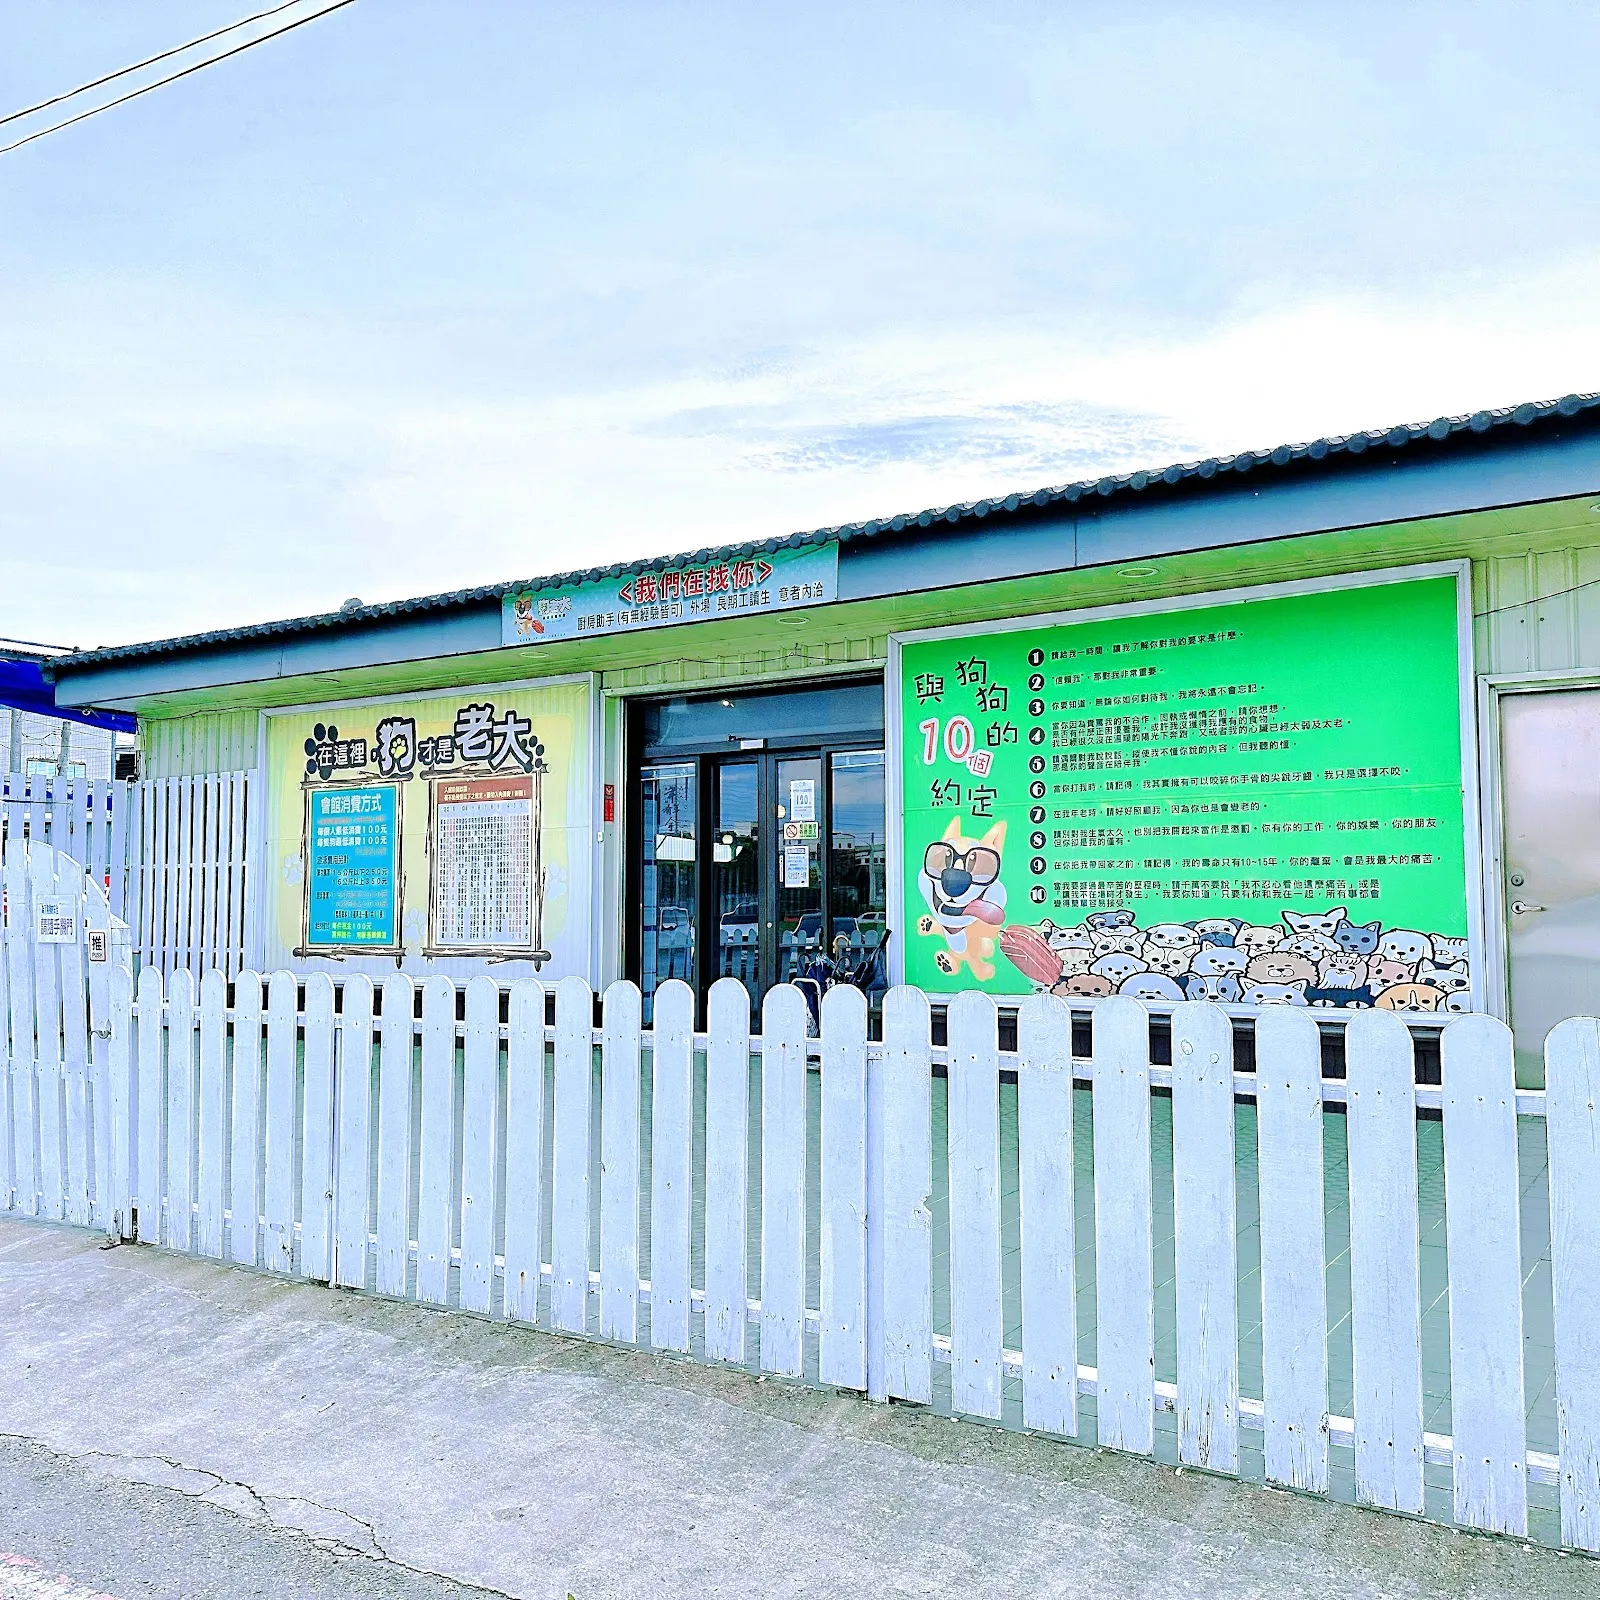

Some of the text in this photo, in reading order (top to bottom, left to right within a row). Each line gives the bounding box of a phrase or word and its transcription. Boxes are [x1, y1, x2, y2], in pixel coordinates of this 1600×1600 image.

[690, 598, 710, 615] 外場
[321, 793, 382, 814] 會館消費方式
[930, 778, 998, 818] 約定
[92, 935, 103, 951] 推
